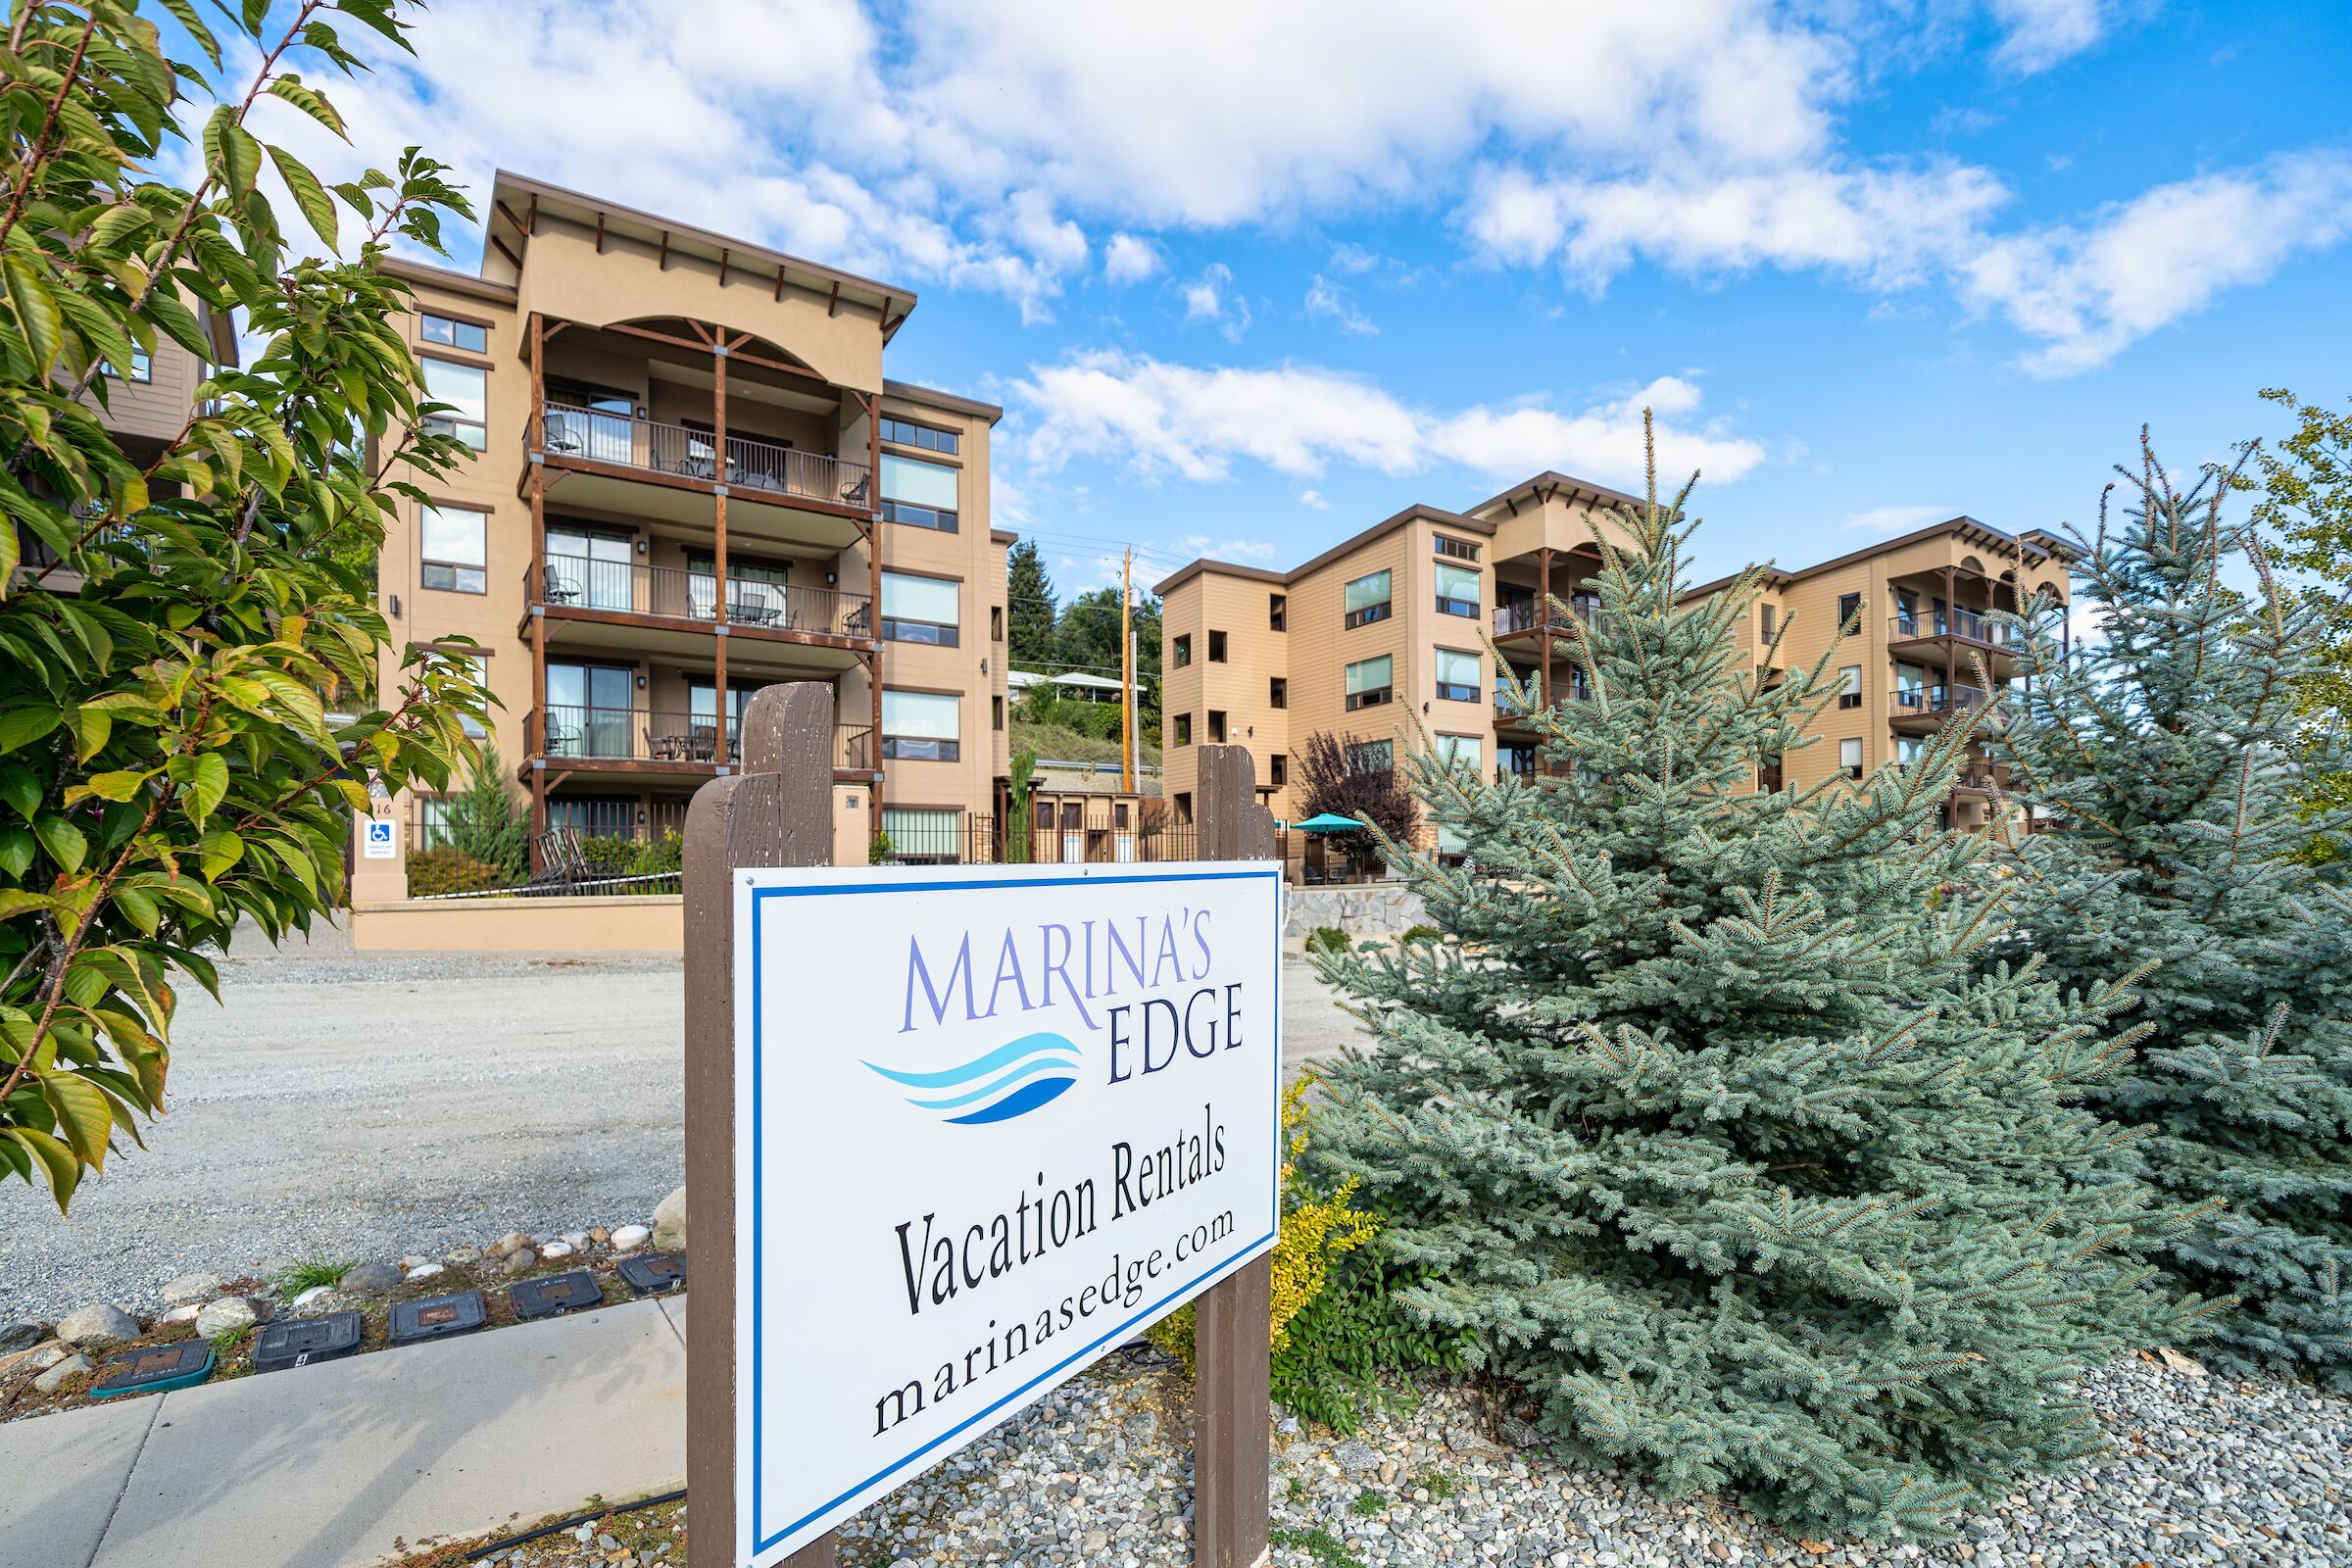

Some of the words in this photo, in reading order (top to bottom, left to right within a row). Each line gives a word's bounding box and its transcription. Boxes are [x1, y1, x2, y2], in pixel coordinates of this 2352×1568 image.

[898, 906, 1211, 1033] MARINA'S
[1107, 982, 1243, 1086] EDGE
[895, 1171, 1097, 1316] Vacation
[1111, 1102, 1226, 1222] Rentals
[872, 1208, 1235, 1439] marinasedge.com
